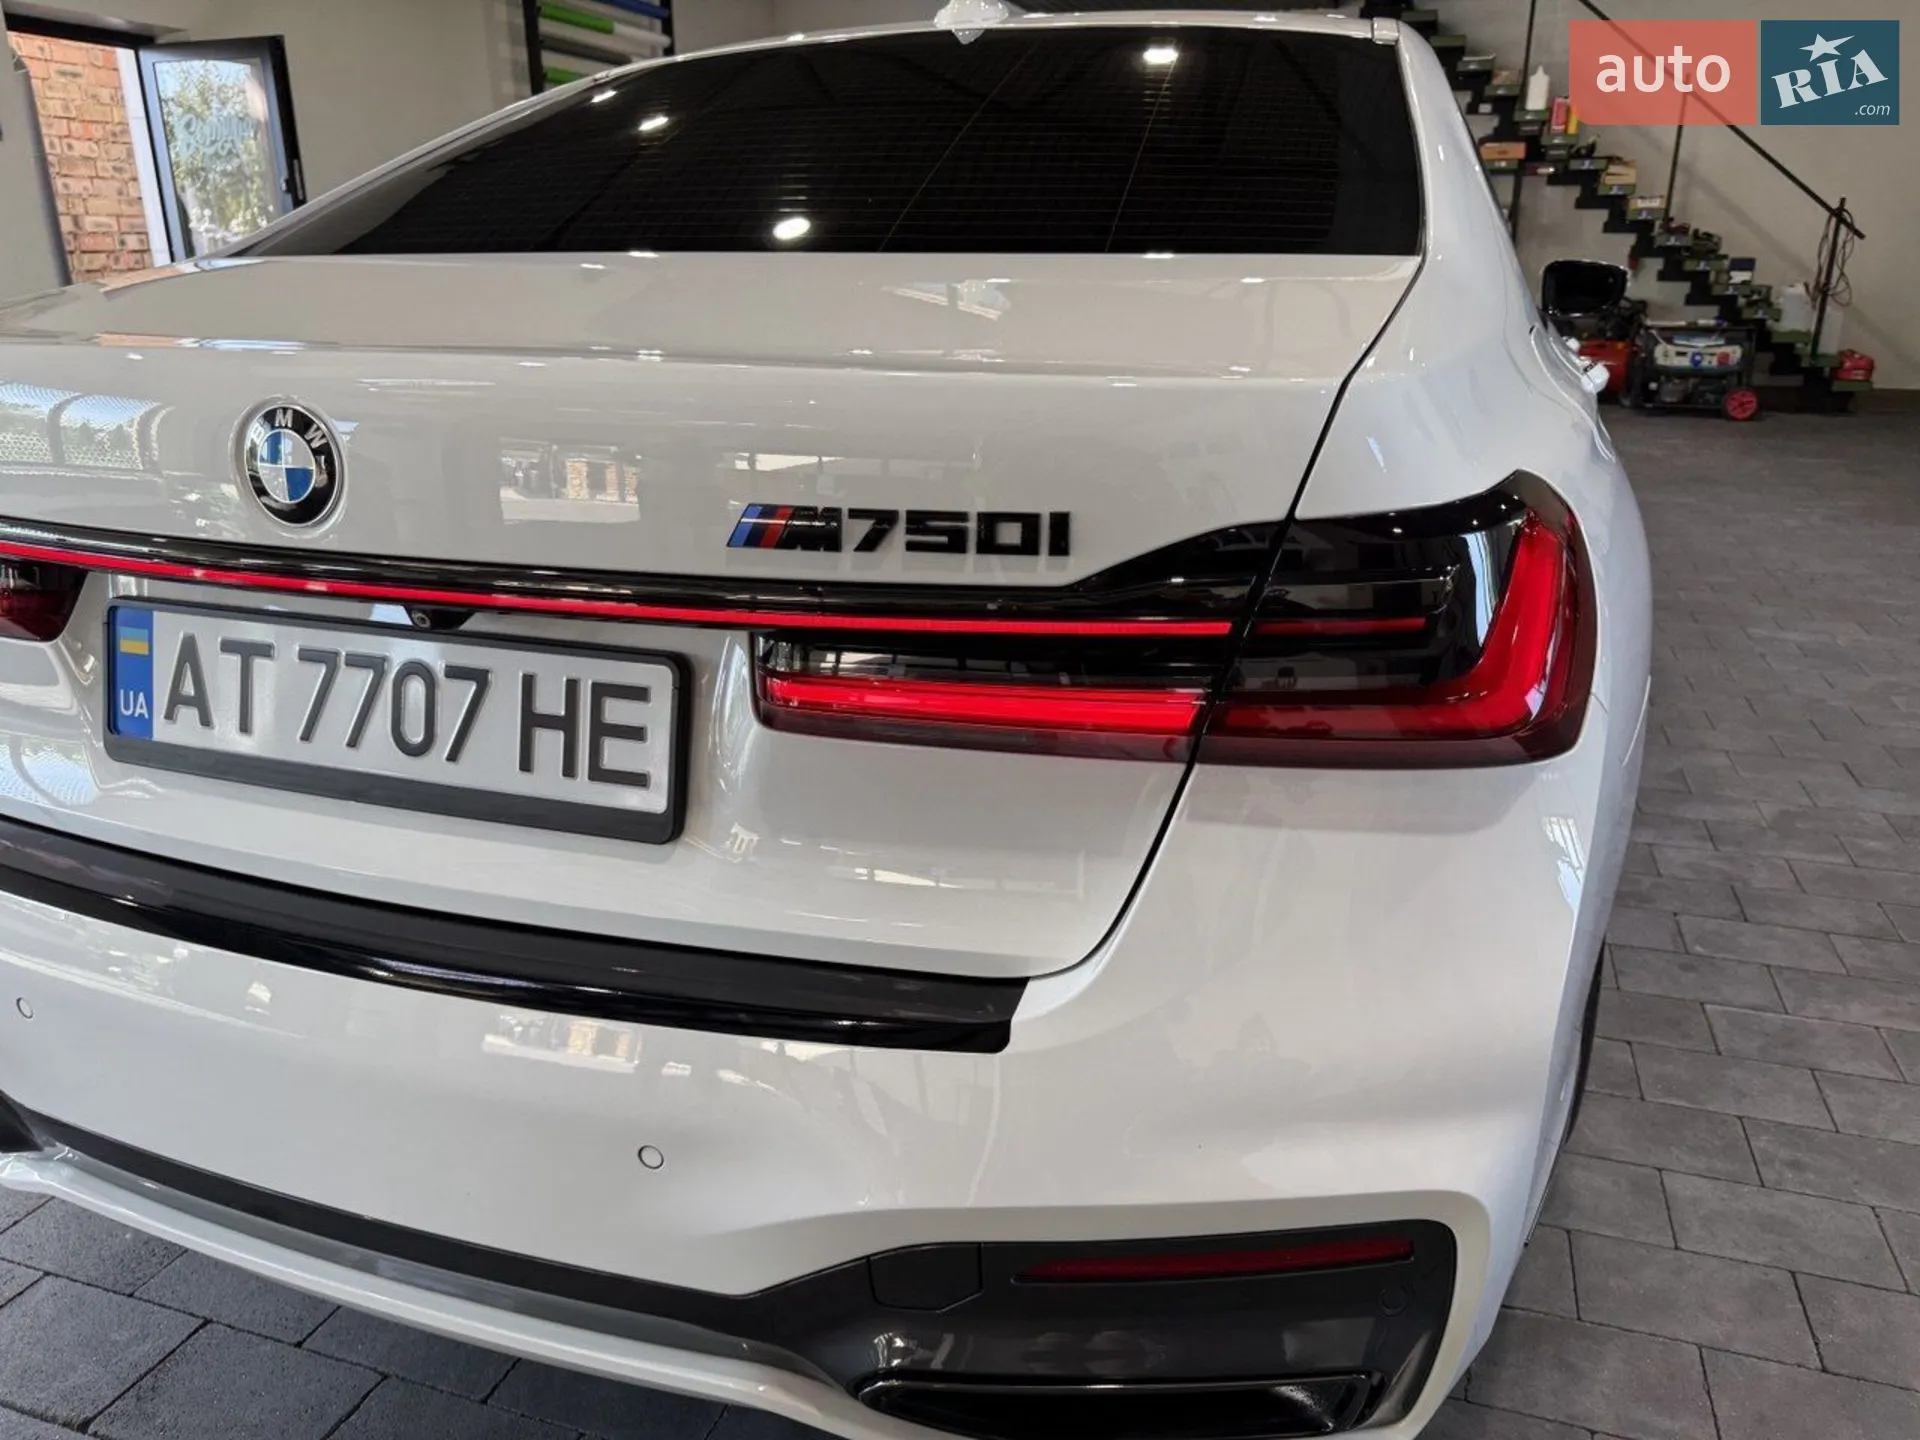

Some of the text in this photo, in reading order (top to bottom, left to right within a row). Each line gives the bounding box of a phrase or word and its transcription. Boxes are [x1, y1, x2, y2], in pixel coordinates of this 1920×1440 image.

[250, 407, 328, 449] BMW
[119, 689, 149, 720] UA
[162, 632, 652, 788] AT 7707 HE
